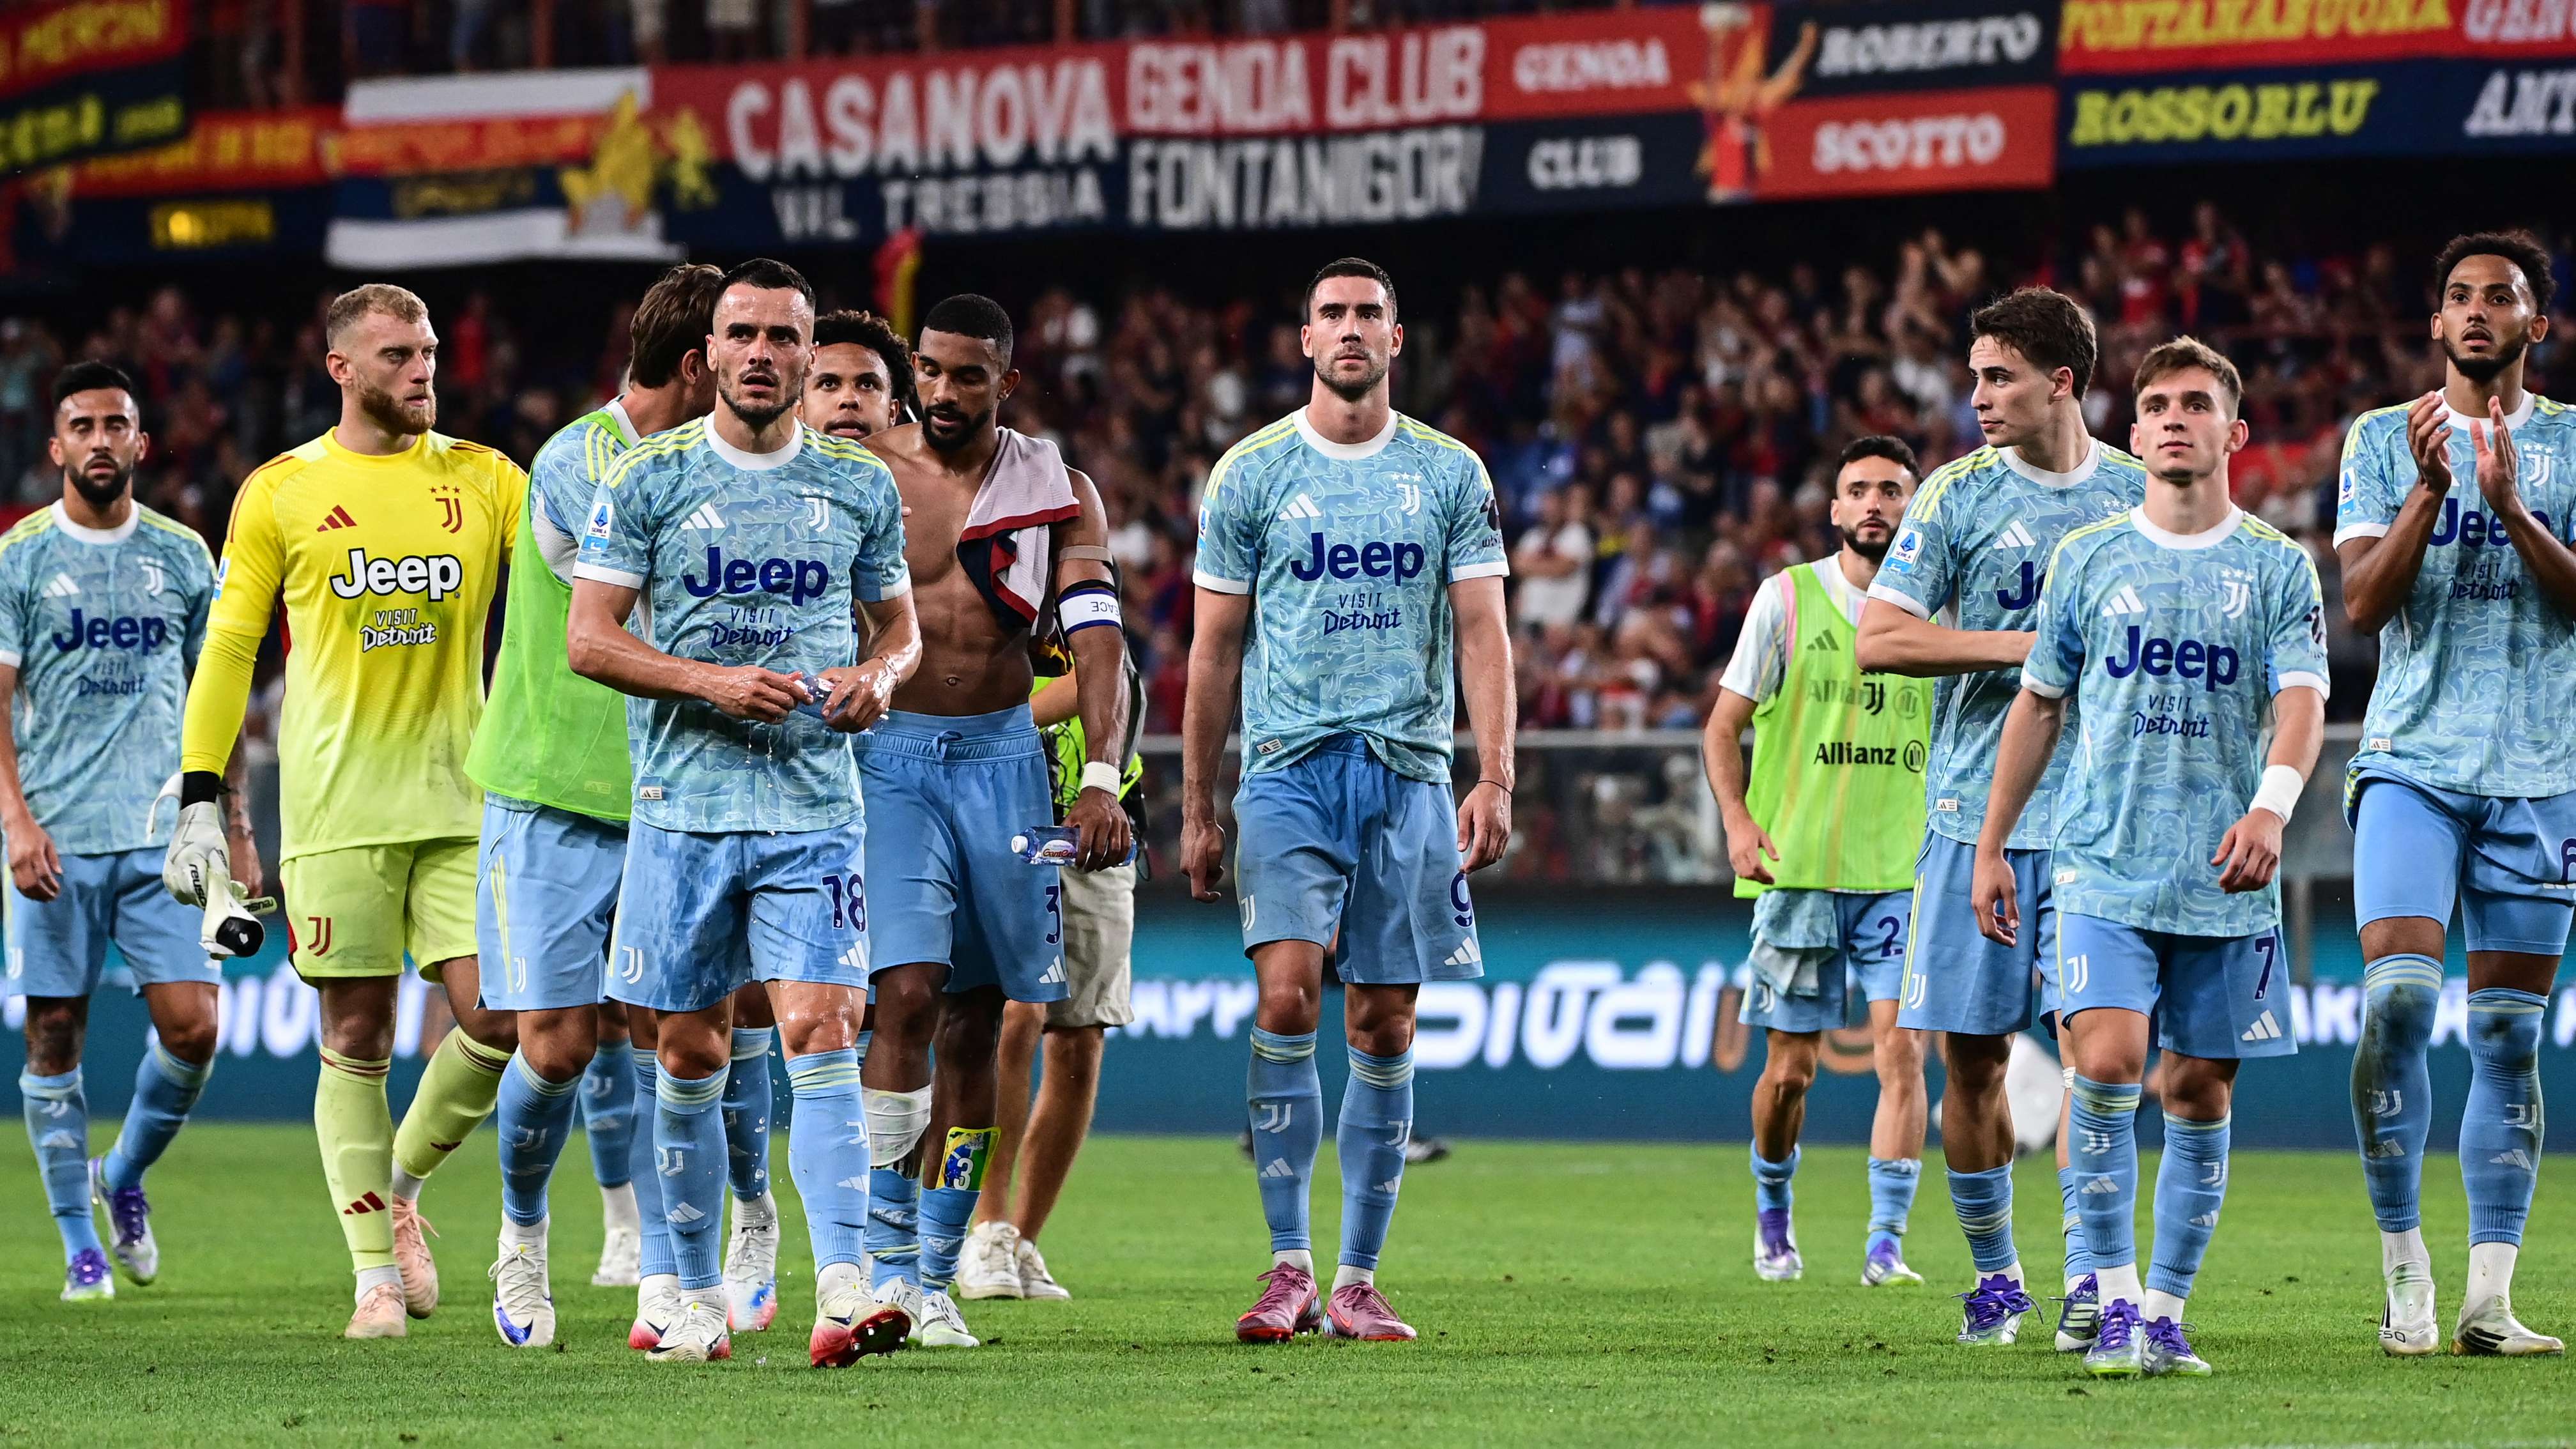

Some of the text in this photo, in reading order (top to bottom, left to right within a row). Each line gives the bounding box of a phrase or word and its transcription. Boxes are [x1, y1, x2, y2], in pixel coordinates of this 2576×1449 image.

[2464, 0, 2576, 42] GEN
[1513, 37, 1671, 94] GENOA
[1816, 13, 2041, 77] ROBERTO
[1126, 25, 1486, 132] GENOA CLUB
[726, 59, 1117, 181] CASANOVA
[2069, 79, 2380, 148] ROSSOBLU
[1528, 135, 1643, 190] CLUB
[1812, 113, 2006, 174] SCOTTO
[330, 548, 462, 602] Jeep
[683, 546, 828, 606] Jeep
[1291, 532, 1424, 586] Jeep
[2459, 562, 2501, 577] VISIT
[375, 608, 418, 626] VISIT
[730, 608, 776, 624] VISIT
[1091, 601, 1119, 617] EACE
[1321, 608, 1402, 636] Detroit
[1338, 592, 1383, 609] VISIT
[53, 609, 166, 656] Jeep
[360, 623, 436, 652] Detroit
[710, 621, 794, 648] Detroit
[93, 661, 128, 674] VISIT
[2105, 625, 2239, 691] Jeep
[77, 676, 144, 696] Detroit
[2149, 695, 2191, 713] VISIT
[2131, 711, 2209, 738] Detroit
[1814, 742, 1896, 765] Allianz
[189, 864, 208, 910] reusc
[822, 873, 866, 932] 18
[1450, 870, 1475, 928] 9
[1045, 885, 1062, 945] 3
[2254, 936, 2276, 1000] 7
[953, 1157, 974, 1191] 3
